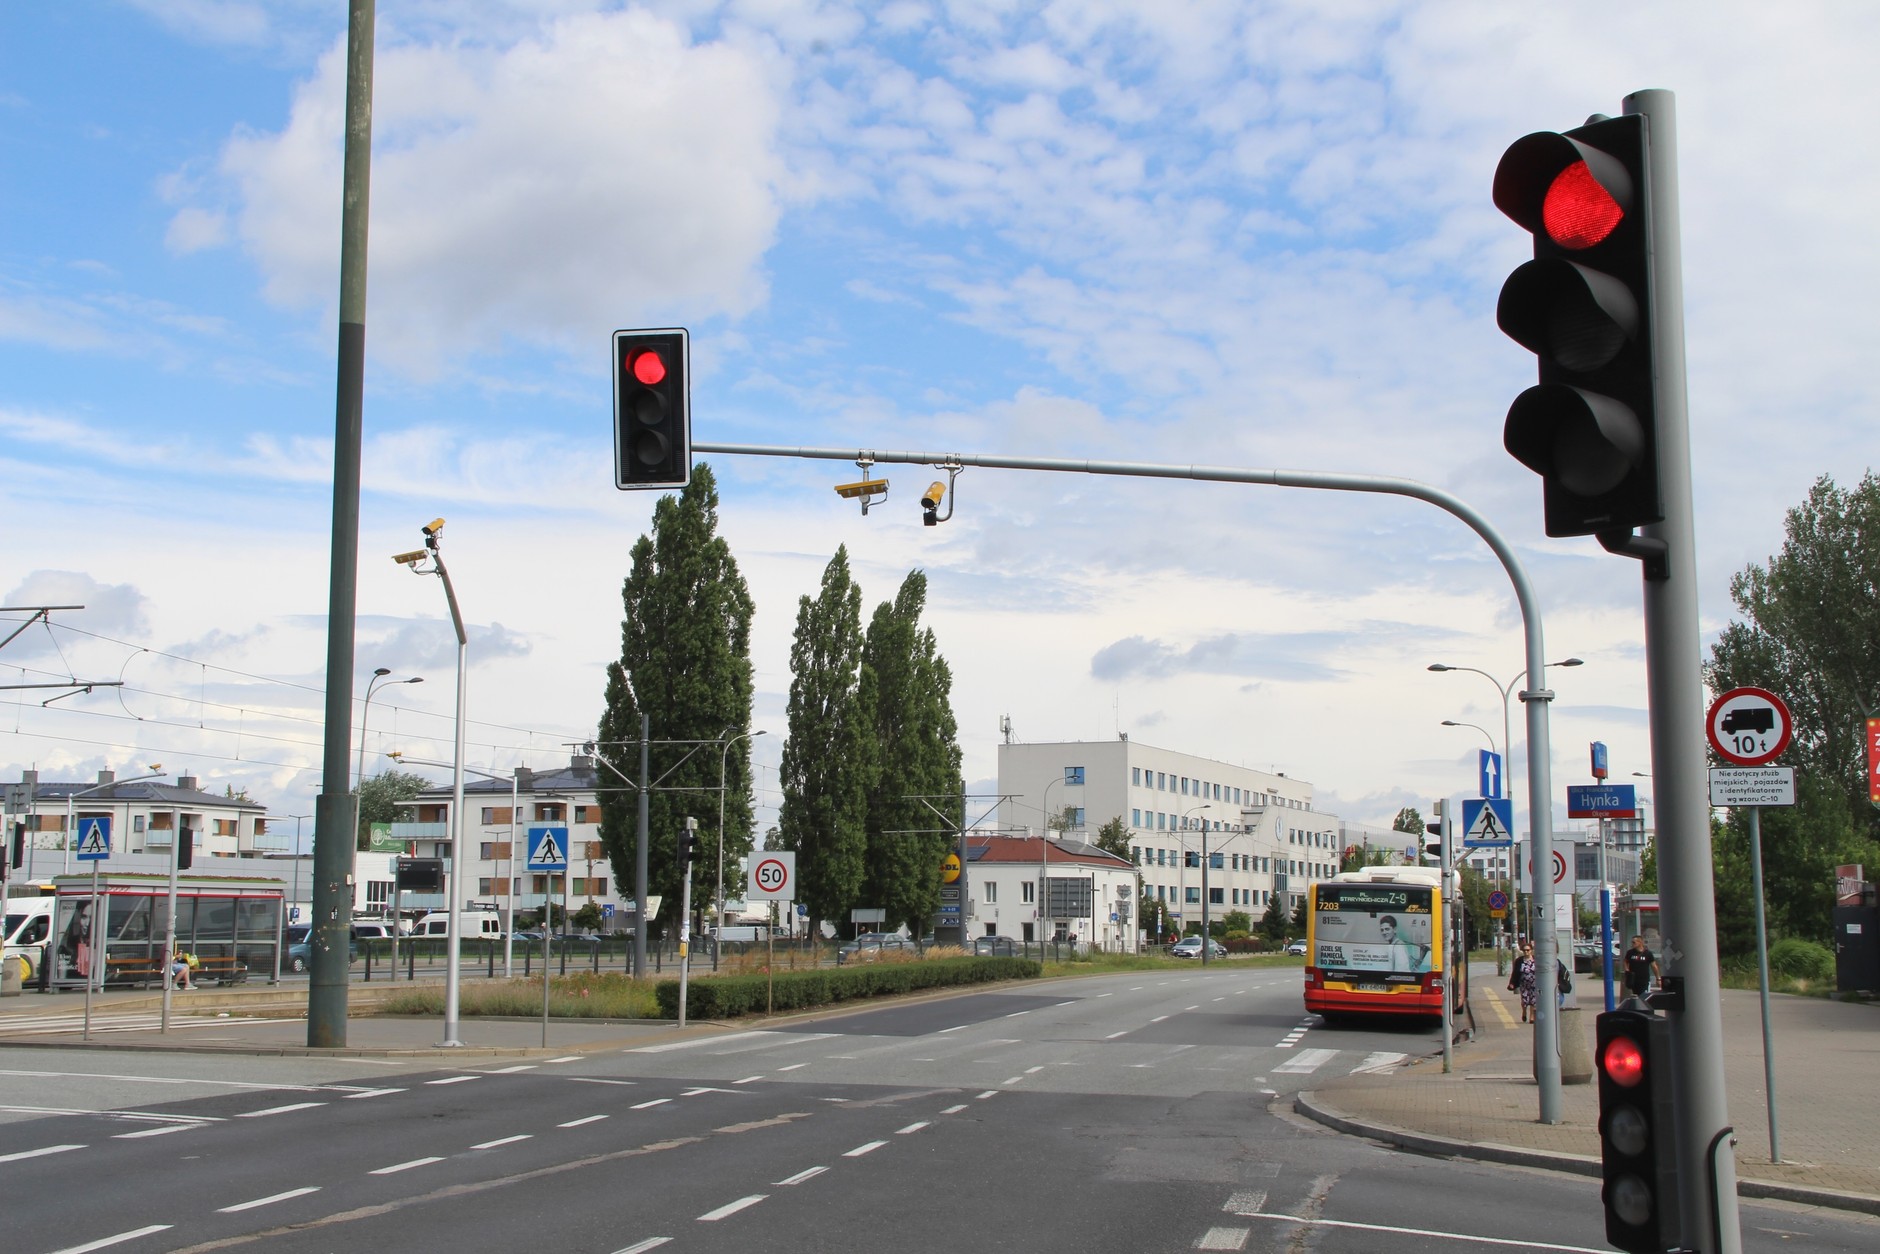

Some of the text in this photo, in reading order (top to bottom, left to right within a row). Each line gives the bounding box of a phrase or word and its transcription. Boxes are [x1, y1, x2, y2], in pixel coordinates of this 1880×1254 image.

[1733, 736, 1767, 754] 10 t
[1733, 770, 1759, 778] dotyczy
[1725, 787, 1783, 795] identyfikatorem
[1581, 793, 1619, 810] Hynka
[761, 868, 782, 883] 50
[1389, 892, 1407, 904] Z-9
[1319, 902, 1339, 911] 7203
[1322, 916, 1330, 925] 81
